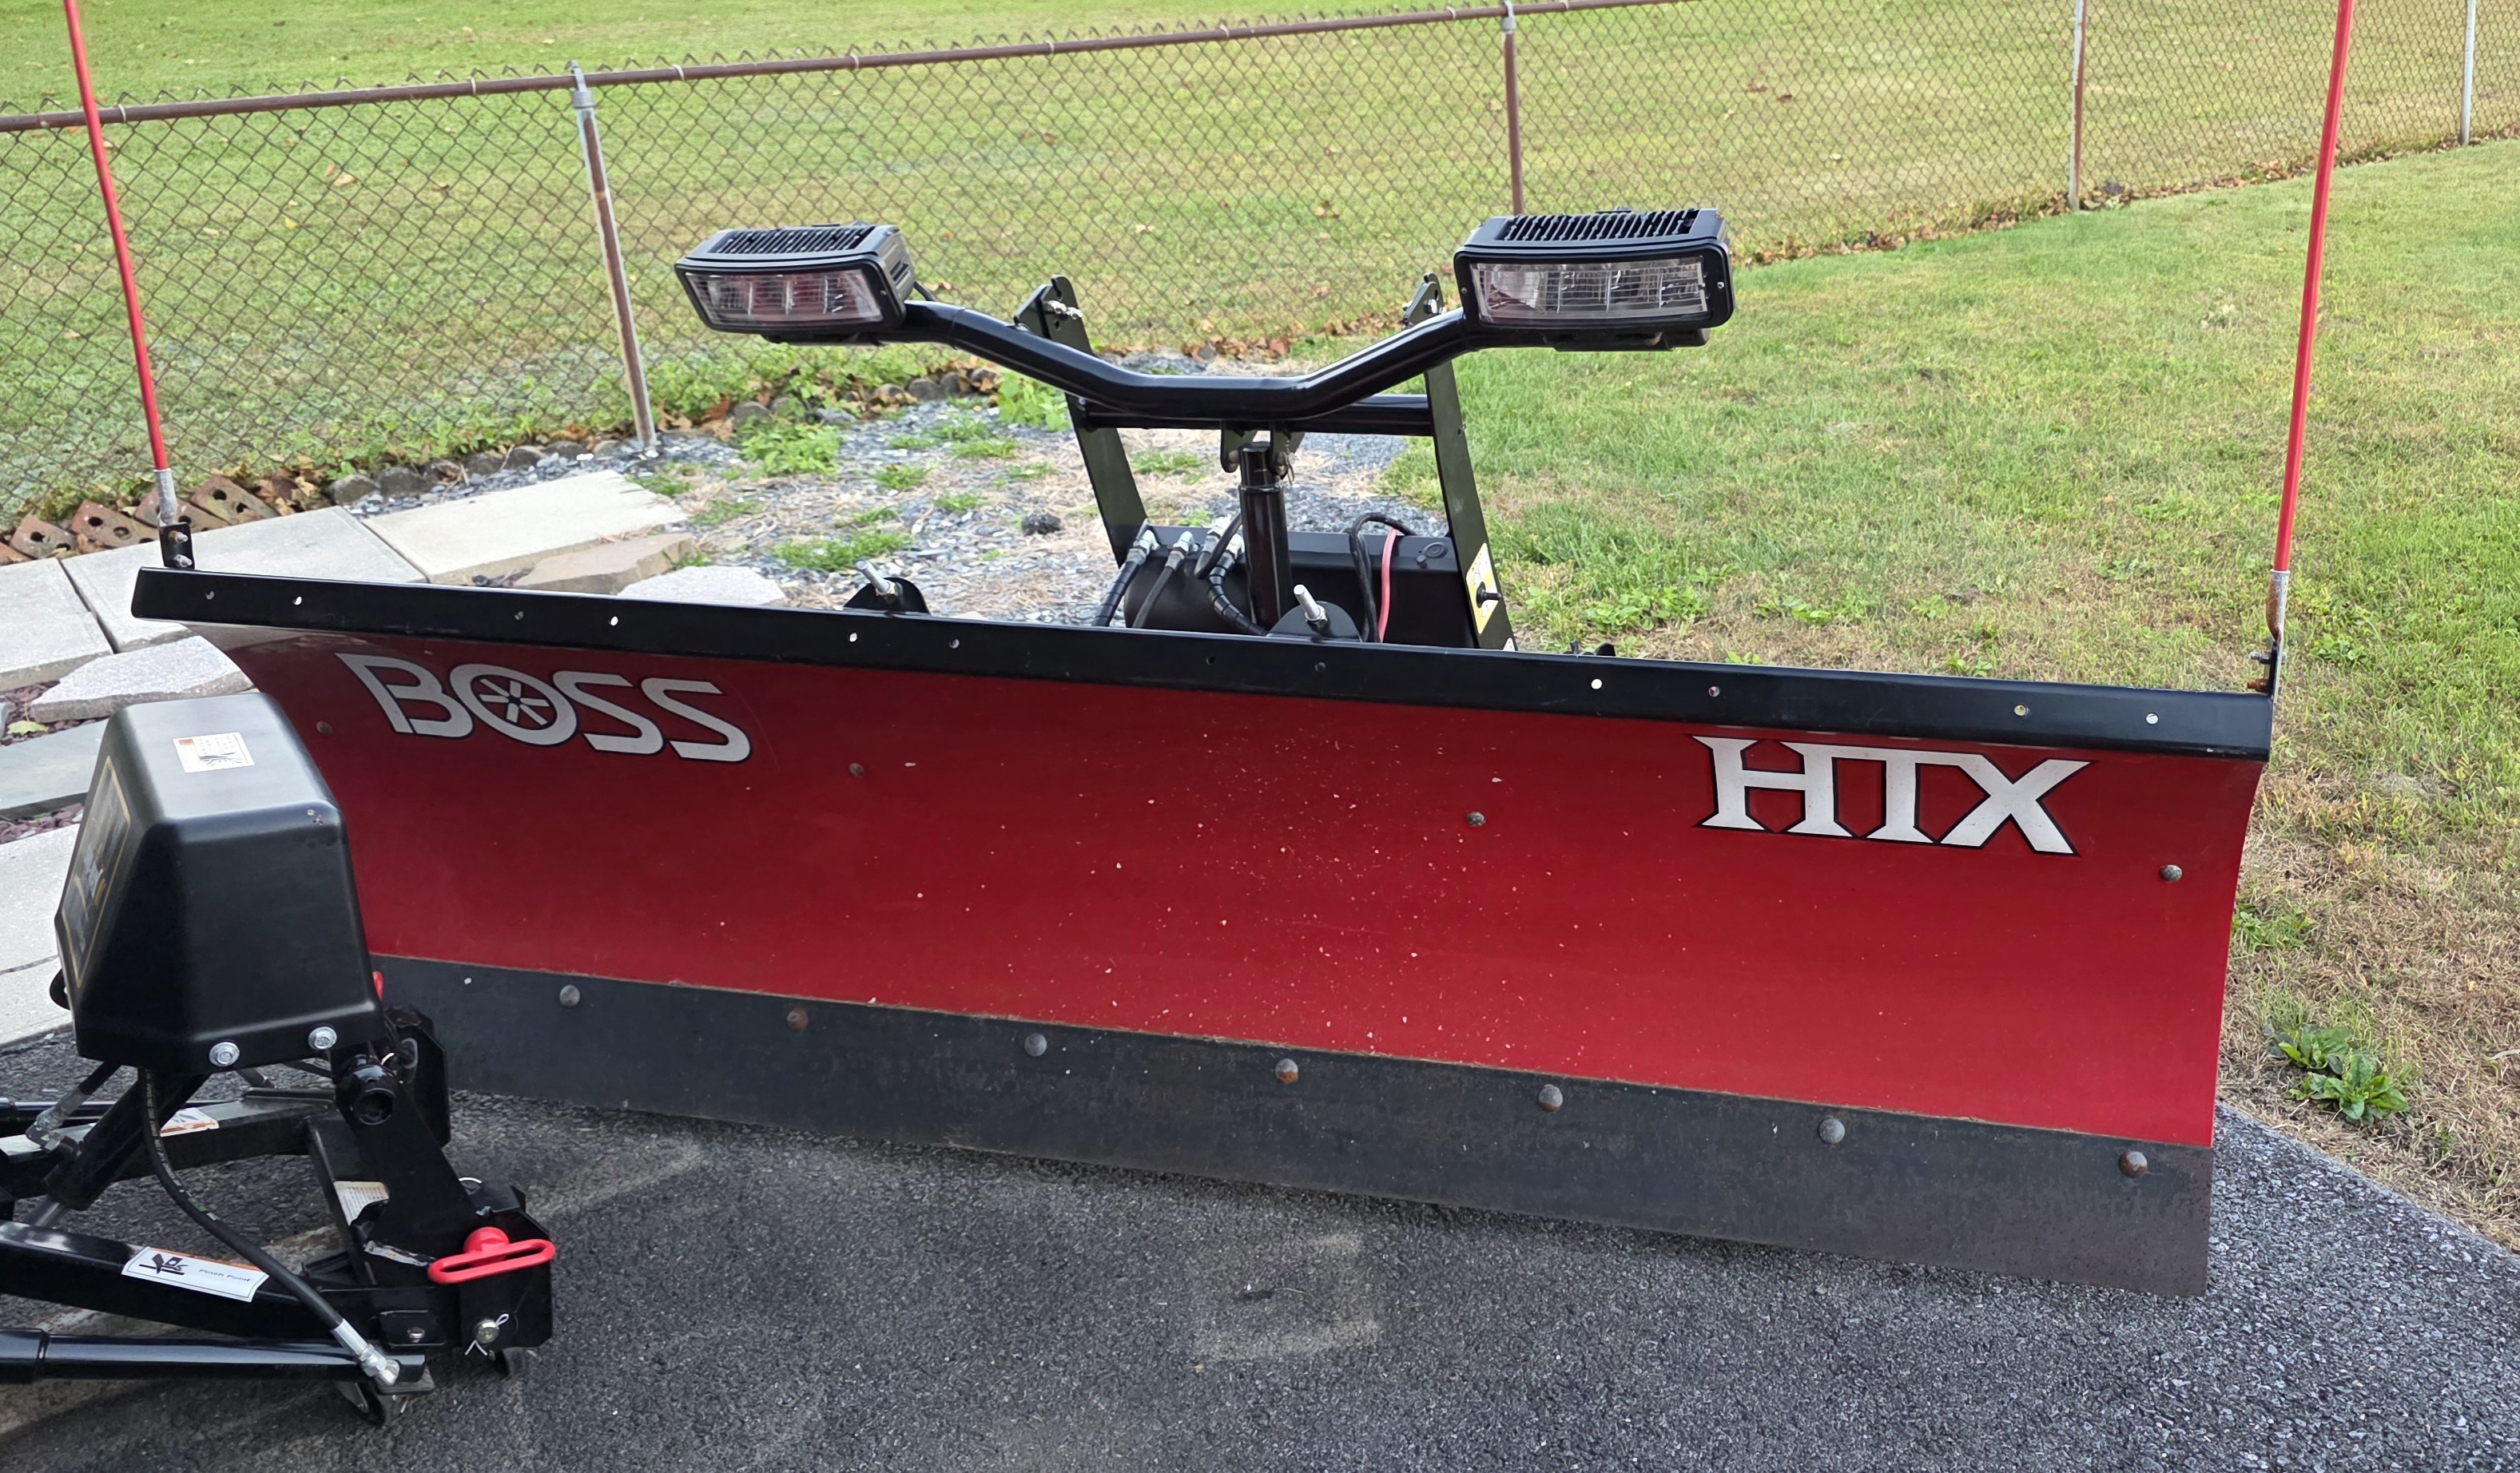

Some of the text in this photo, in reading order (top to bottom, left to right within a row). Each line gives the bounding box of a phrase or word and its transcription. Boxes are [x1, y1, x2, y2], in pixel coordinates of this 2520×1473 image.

[334, 652, 753, 762] BOSS
[1689, 735, 2093, 856] HTX
[198, 1269, 251, 1283] Pinch Point
